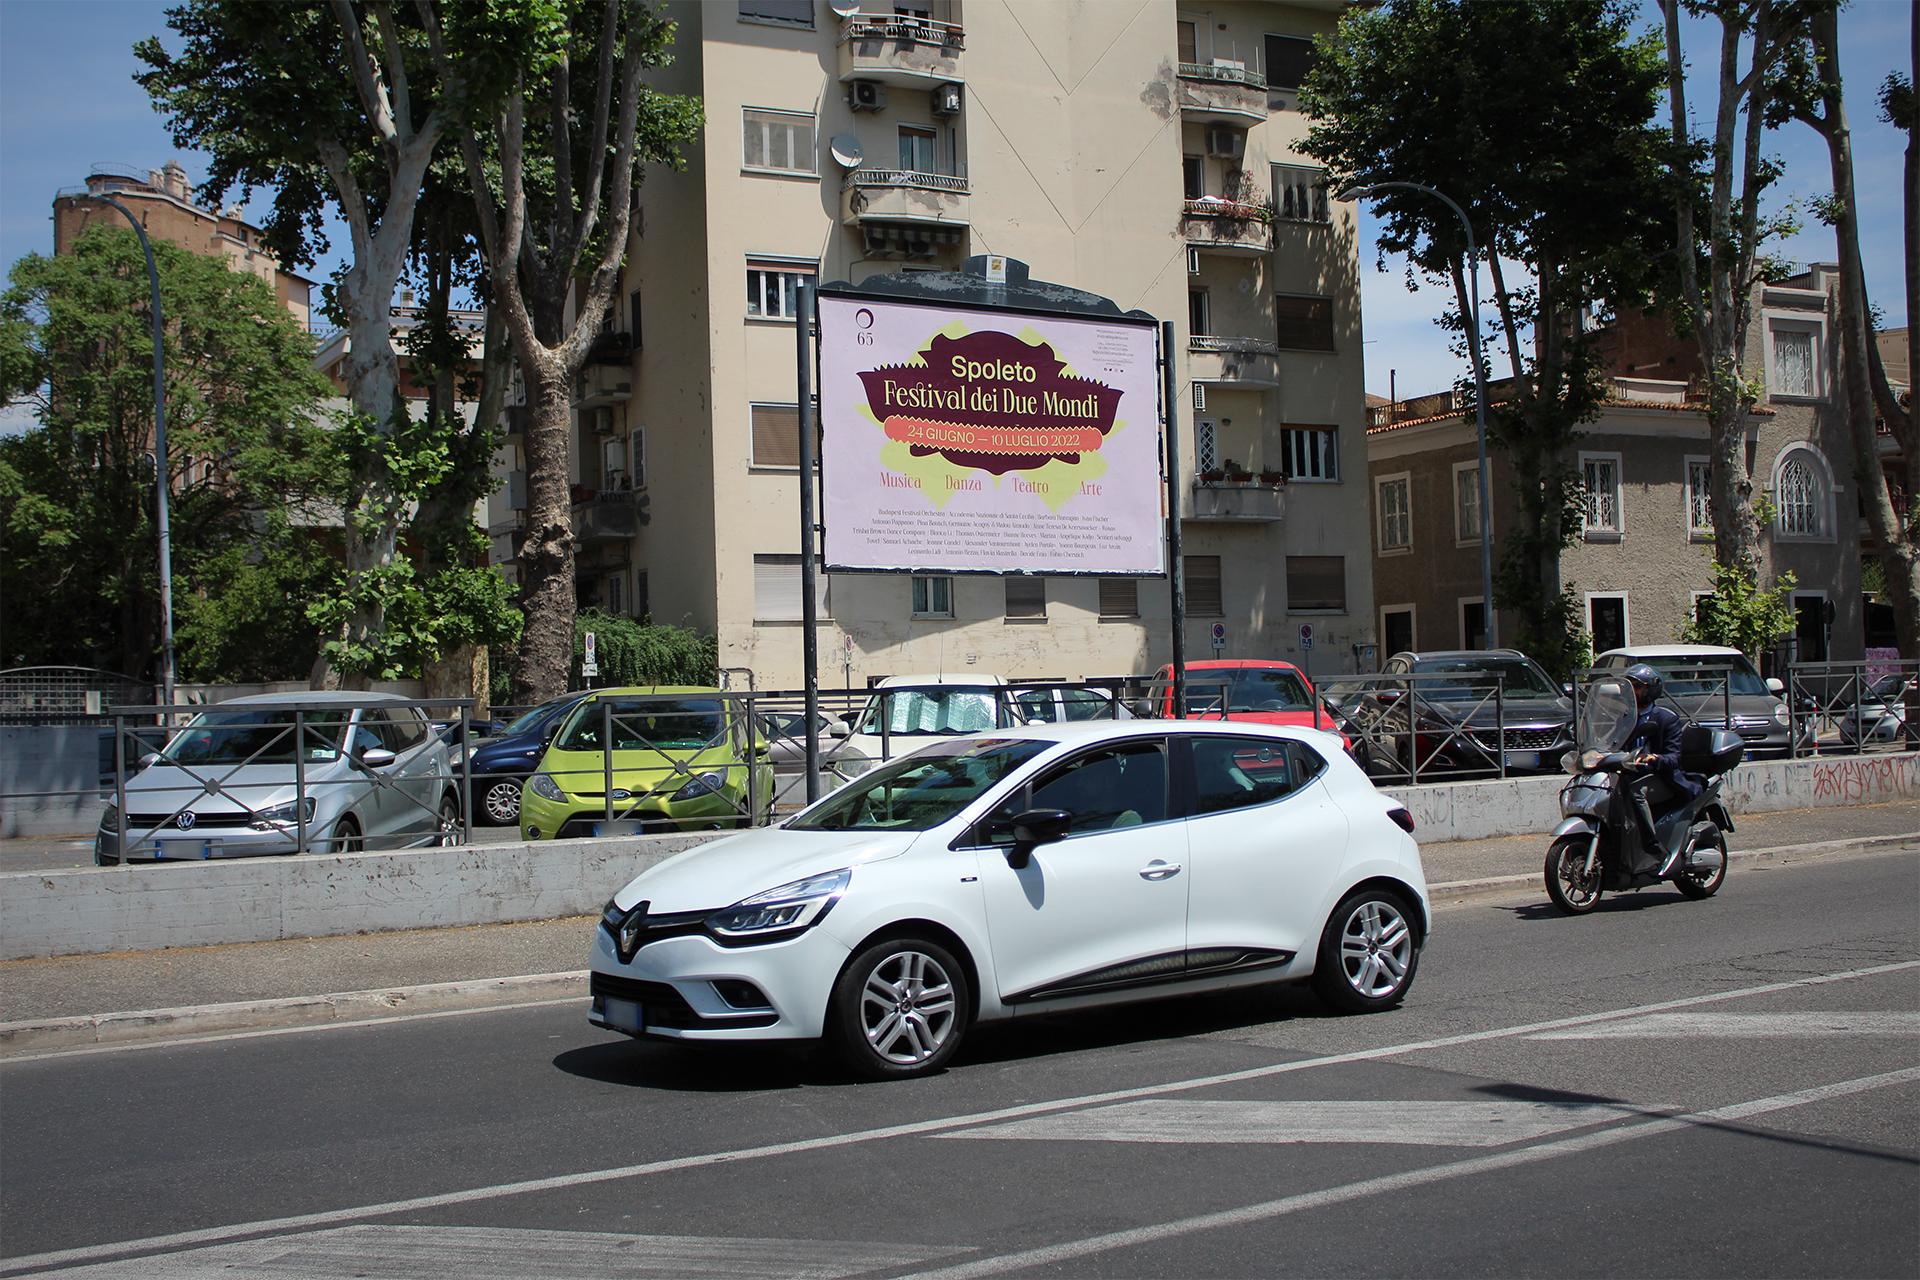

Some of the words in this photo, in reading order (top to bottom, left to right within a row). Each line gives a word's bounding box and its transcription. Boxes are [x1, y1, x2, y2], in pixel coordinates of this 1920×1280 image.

[857, 331, 873, 346] 65
[951, 355, 1037, 383] Spoleto
[884, 379, 967, 411] Festival
[970, 386, 998, 413] dei
[1003, 387, 1038, 415] Due
[1042, 390, 1100, 419] Mondi
[906, 424, 924, 438] 24
[925, 427, 975, 444] GIUGNO
[991, 433, 1004, 447] 10
[1005, 433, 1049, 447] LUGLIO
[1050, 433, 1080, 447] 2022
[880, 471, 922, 489] Musica
[945, 474, 983, 491] Danza
[1011, 477, 1049, 494] Teatro
[1079, 480, 1103, 497] Arte
